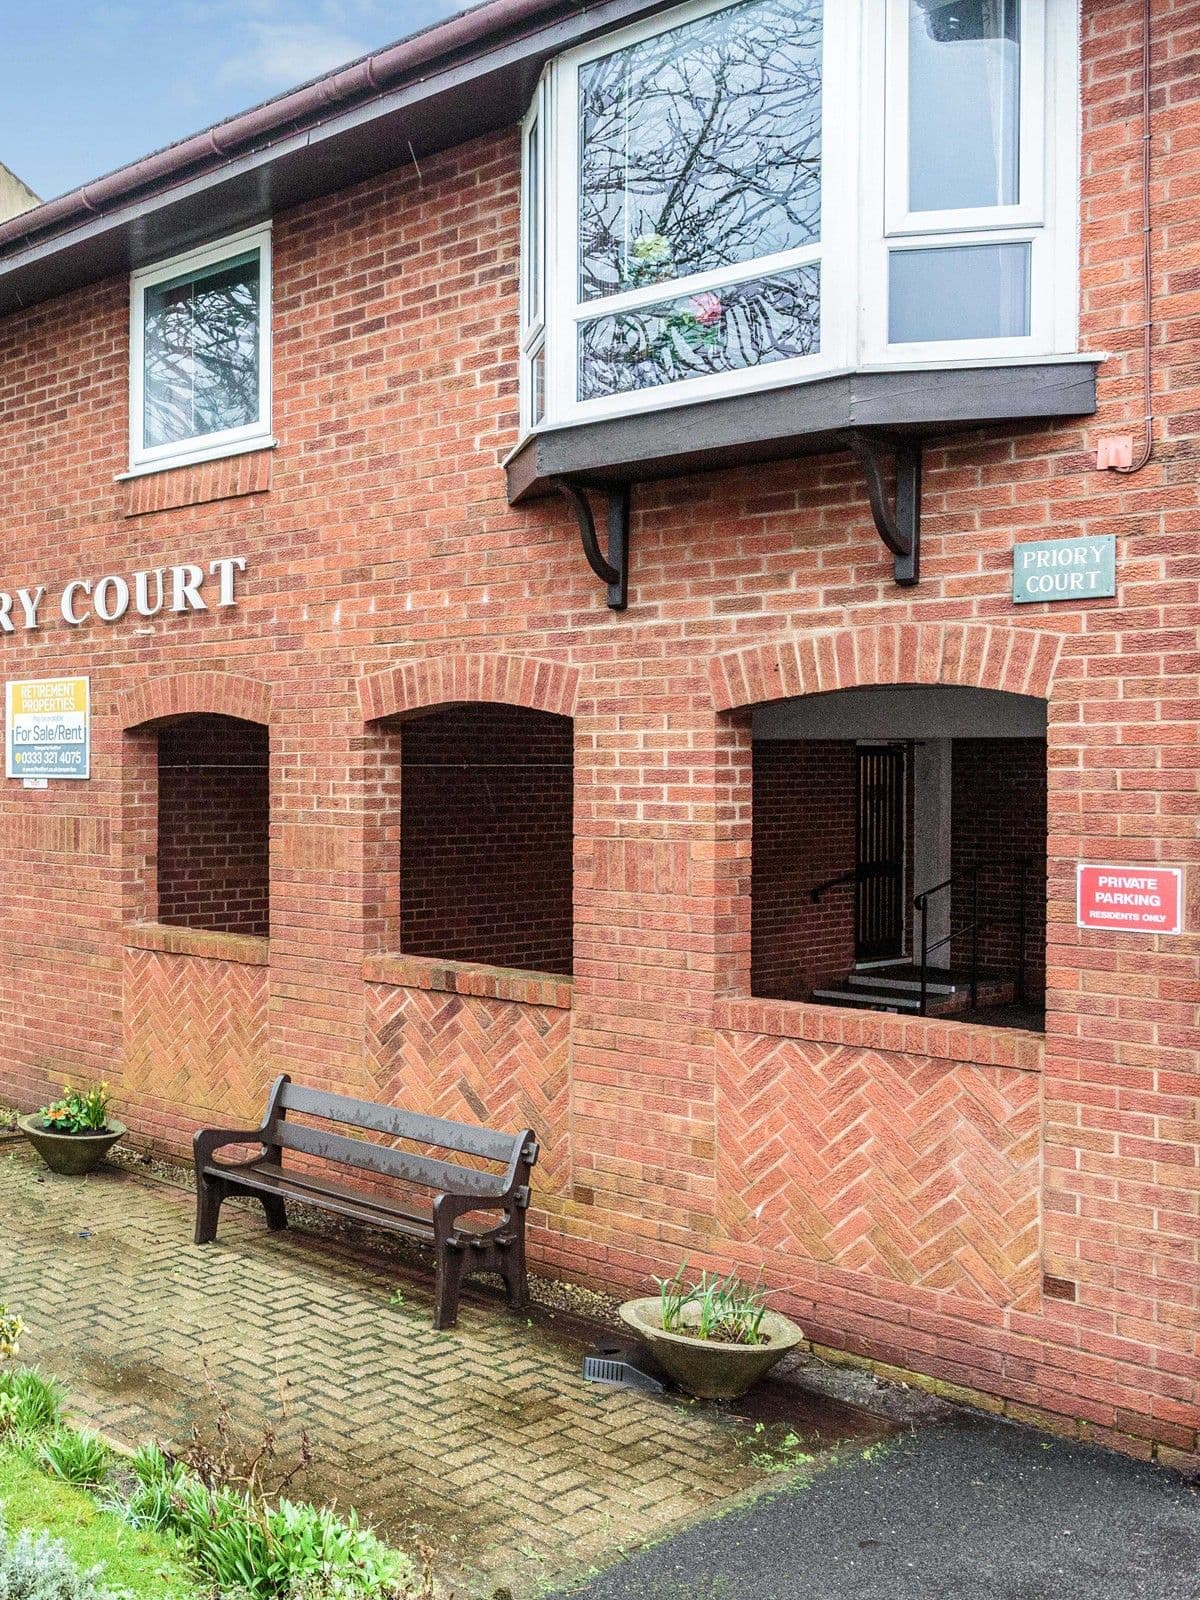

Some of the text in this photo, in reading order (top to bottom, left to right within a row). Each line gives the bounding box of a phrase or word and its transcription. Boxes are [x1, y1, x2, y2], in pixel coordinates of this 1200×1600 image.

[1023, 544, 1106, 569] PRIORY
[1025, 571, 1101, 593] COURT
[60, 556, 247, 626] COURT
[21, 682, 75, 699] RETIREMENT
[21, 697, 76, 713] PROPERTIES
[15, 723, 82, 742] For Sale/Rent
[21, 751, 82, 765] 0333 321 4075
[1097, 876, 1159, 890] PRIVATE
[1094, 891, 1161, 907] PARKING
[1088, 910, 1167, 923] RESIDENTS ONLY
